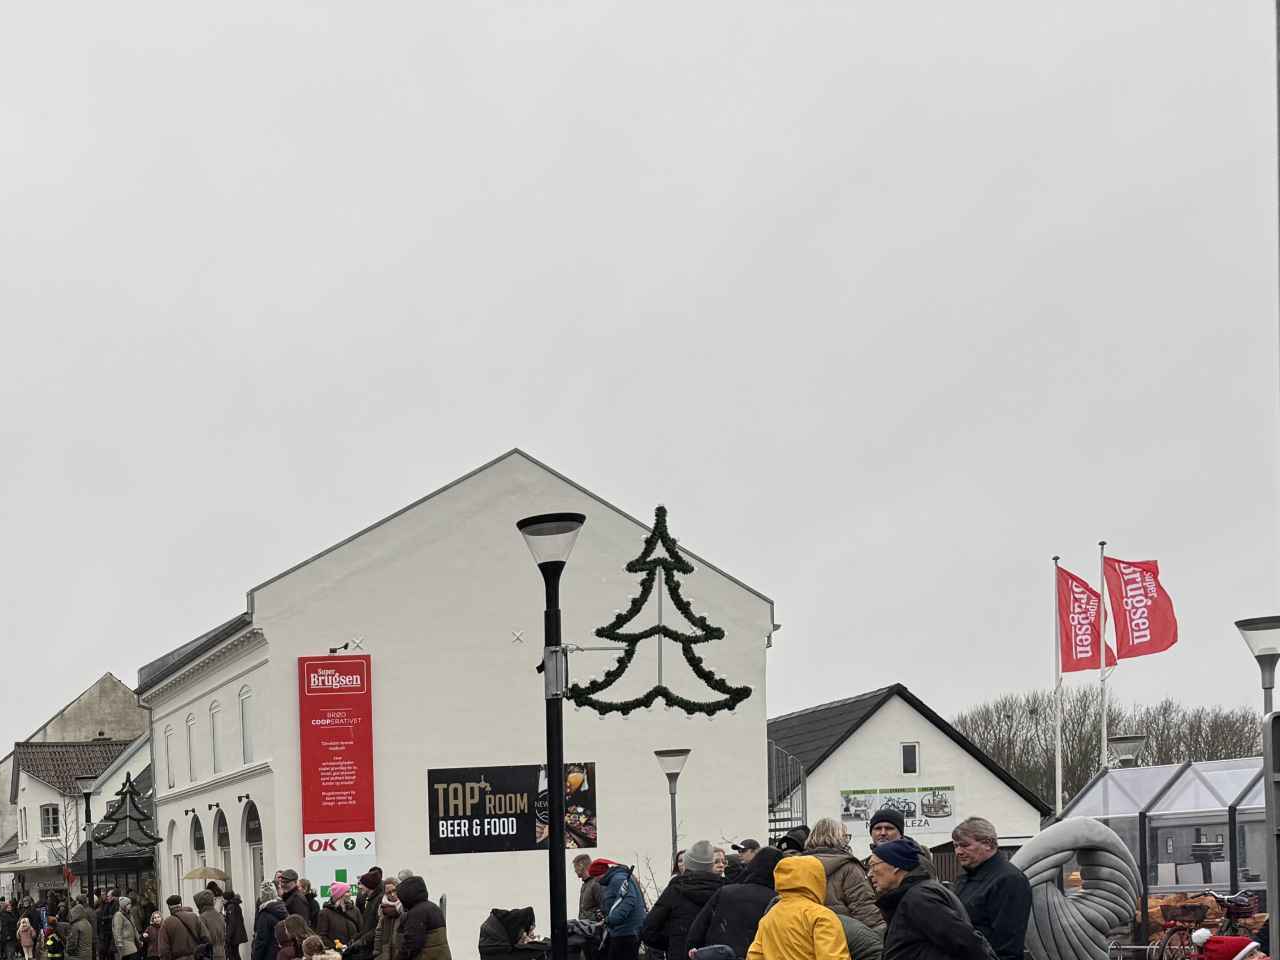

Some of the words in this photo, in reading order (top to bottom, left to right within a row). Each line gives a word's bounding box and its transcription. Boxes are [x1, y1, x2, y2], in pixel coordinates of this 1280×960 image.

[310, 673, 361, 689] Brugsen
[434, 783, 480, 817] TAP
[486, 793, 528, 815] ROOM
[439, 820, 469, 838] BEER
[473, 819, 481, 837] &
[485, 818, 517, 836] FOOD
[308, 838, 338, 852] OK
